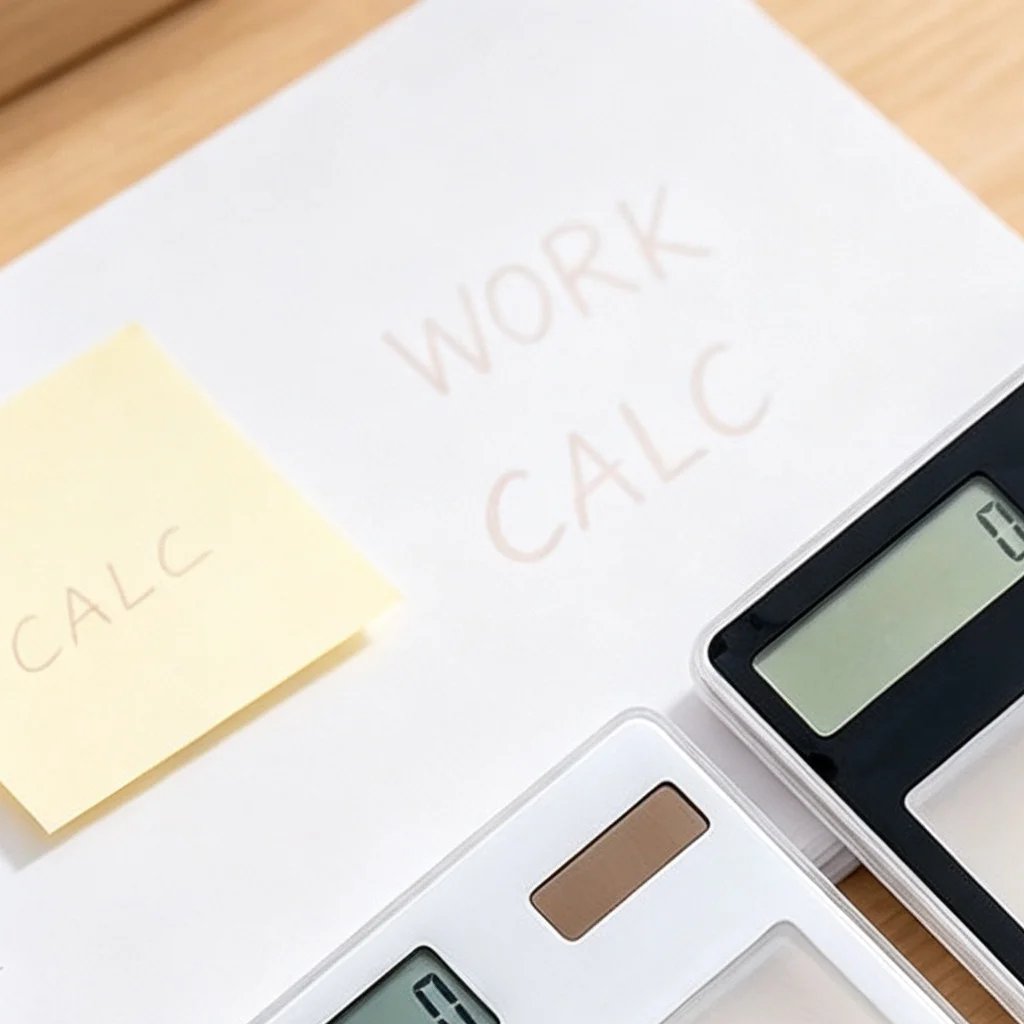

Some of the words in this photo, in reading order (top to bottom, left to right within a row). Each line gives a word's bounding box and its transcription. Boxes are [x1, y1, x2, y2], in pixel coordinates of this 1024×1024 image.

[381, 185, 713, 396] WORK
[484, 341, 772, 564] CALC
[10, 525, 213, 673] CALC
